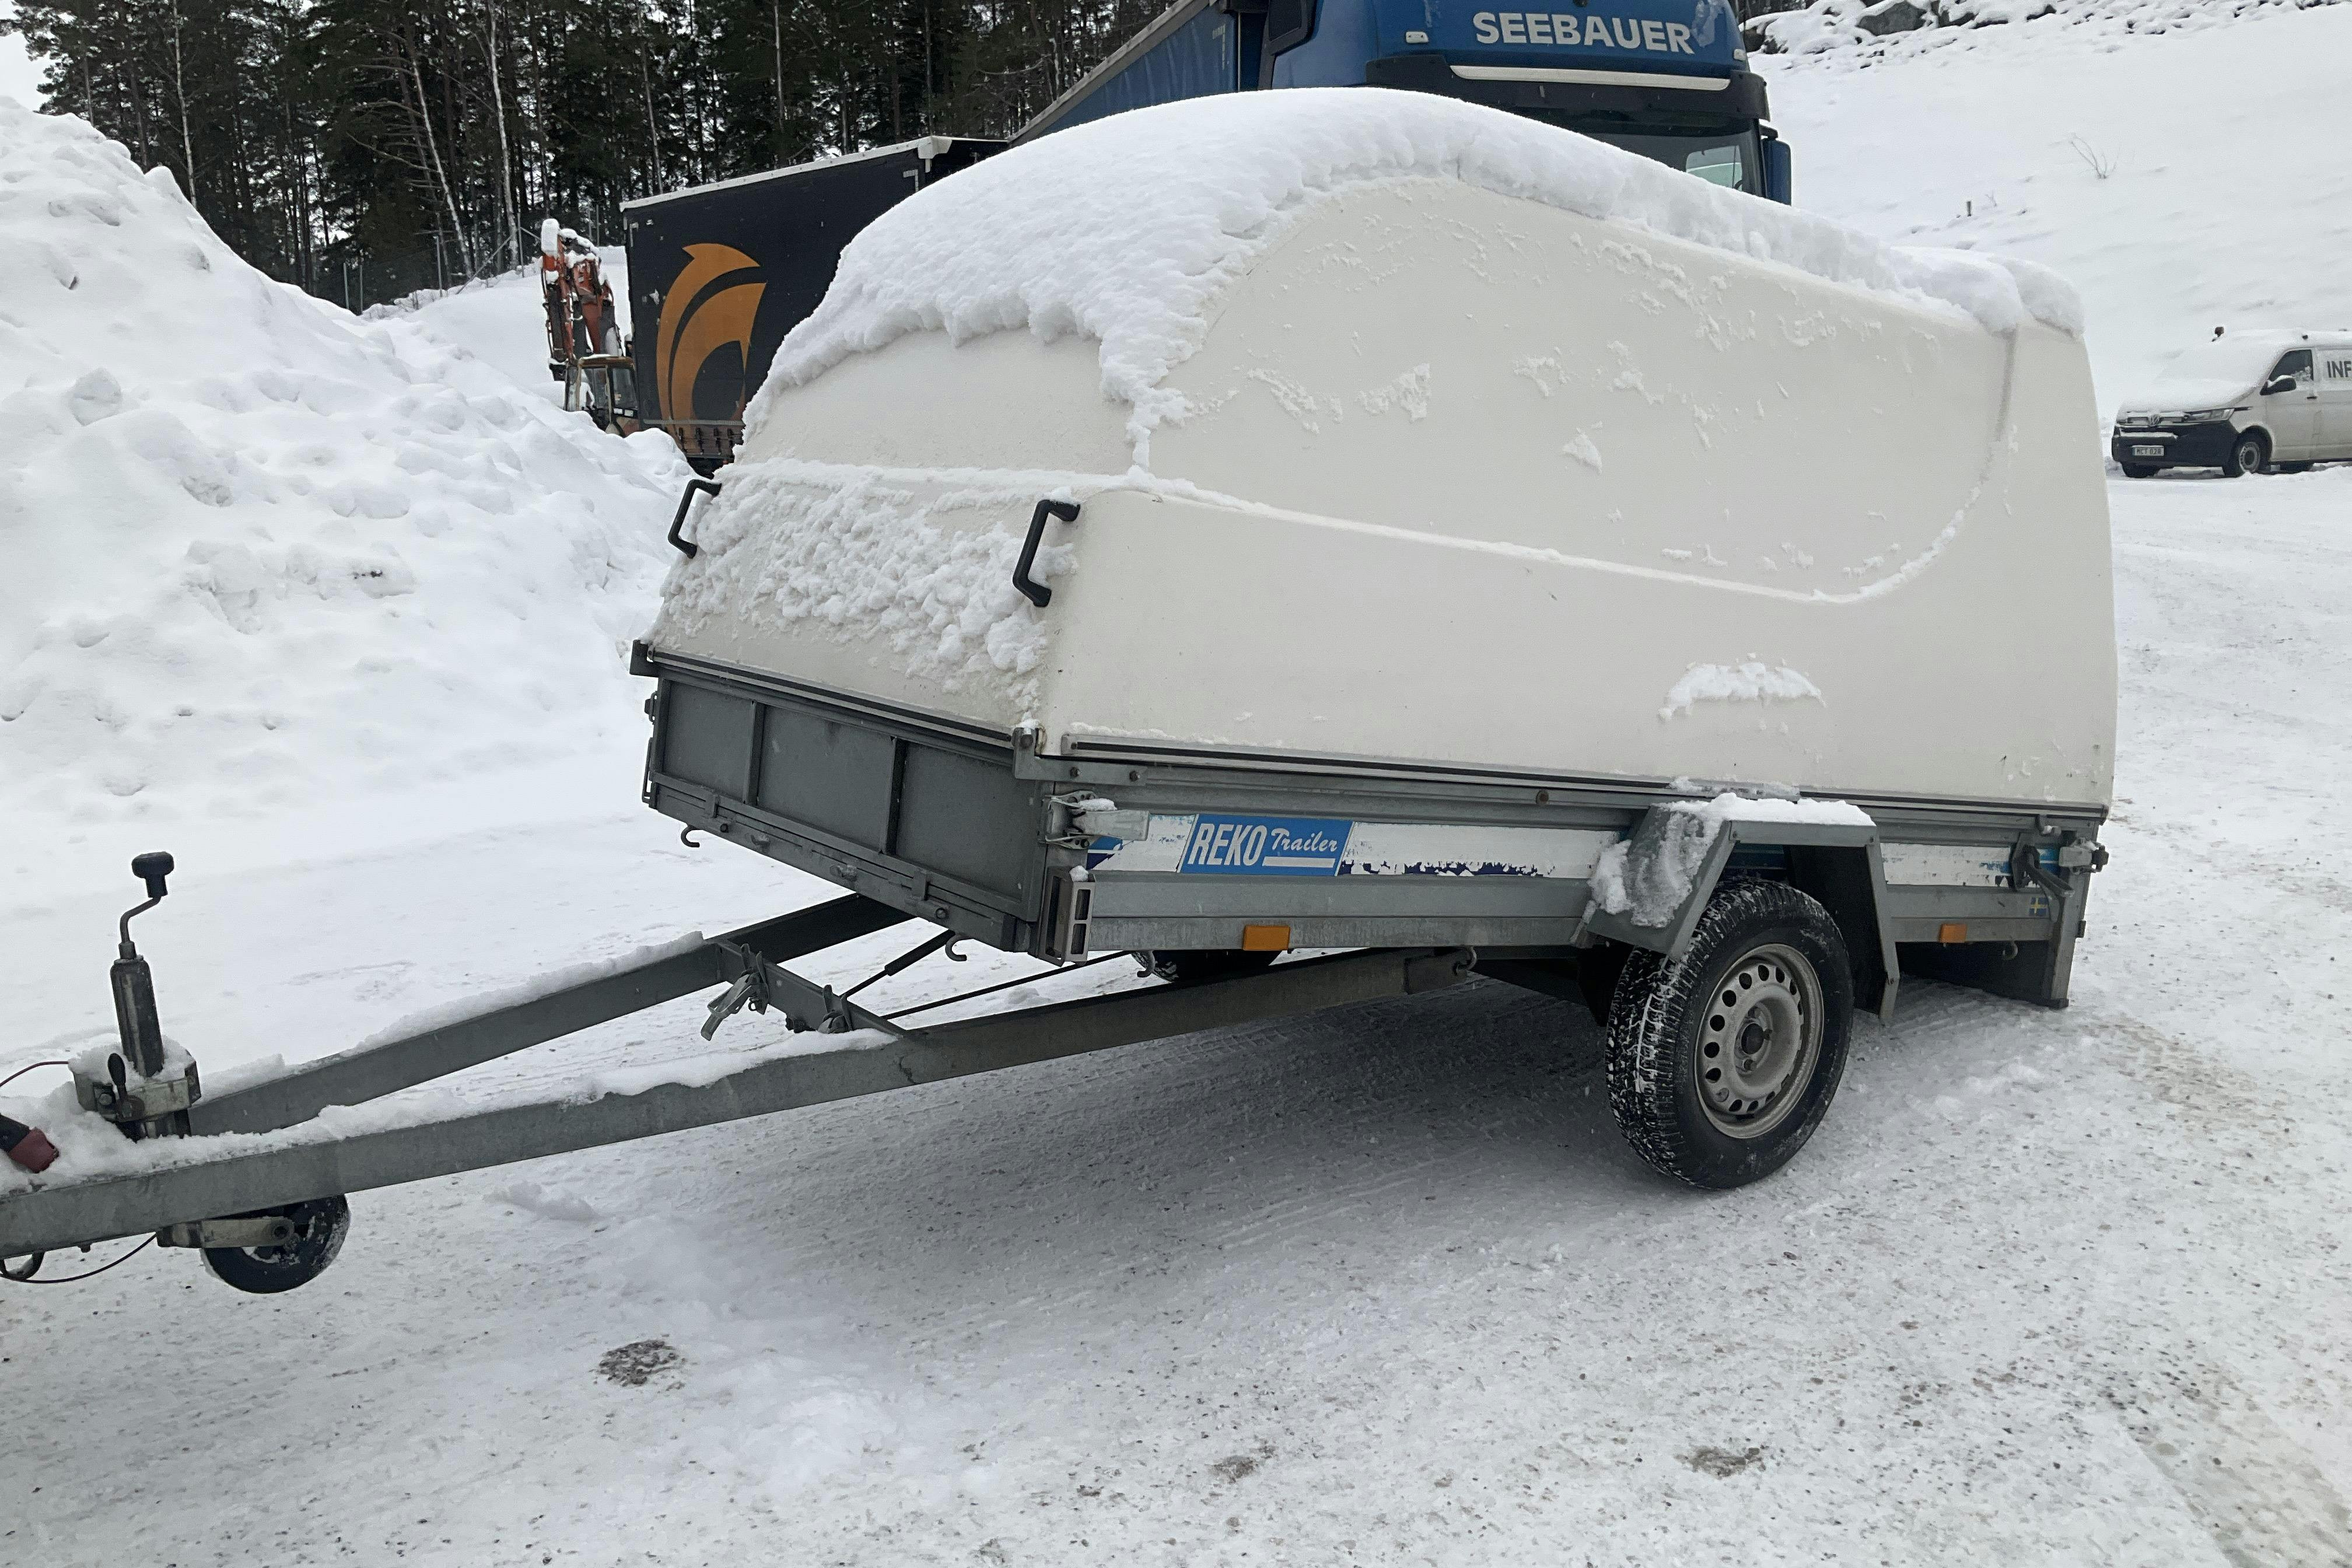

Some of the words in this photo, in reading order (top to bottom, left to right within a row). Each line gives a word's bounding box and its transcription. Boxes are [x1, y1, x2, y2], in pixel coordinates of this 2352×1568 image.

[1473, 12, 1695, 54] SEEBAUER
[2327, 360, 2352, 378] INF
[1188, 823, 1267, 866] REKO
[1271, 828, 1338, 852] Trailer
